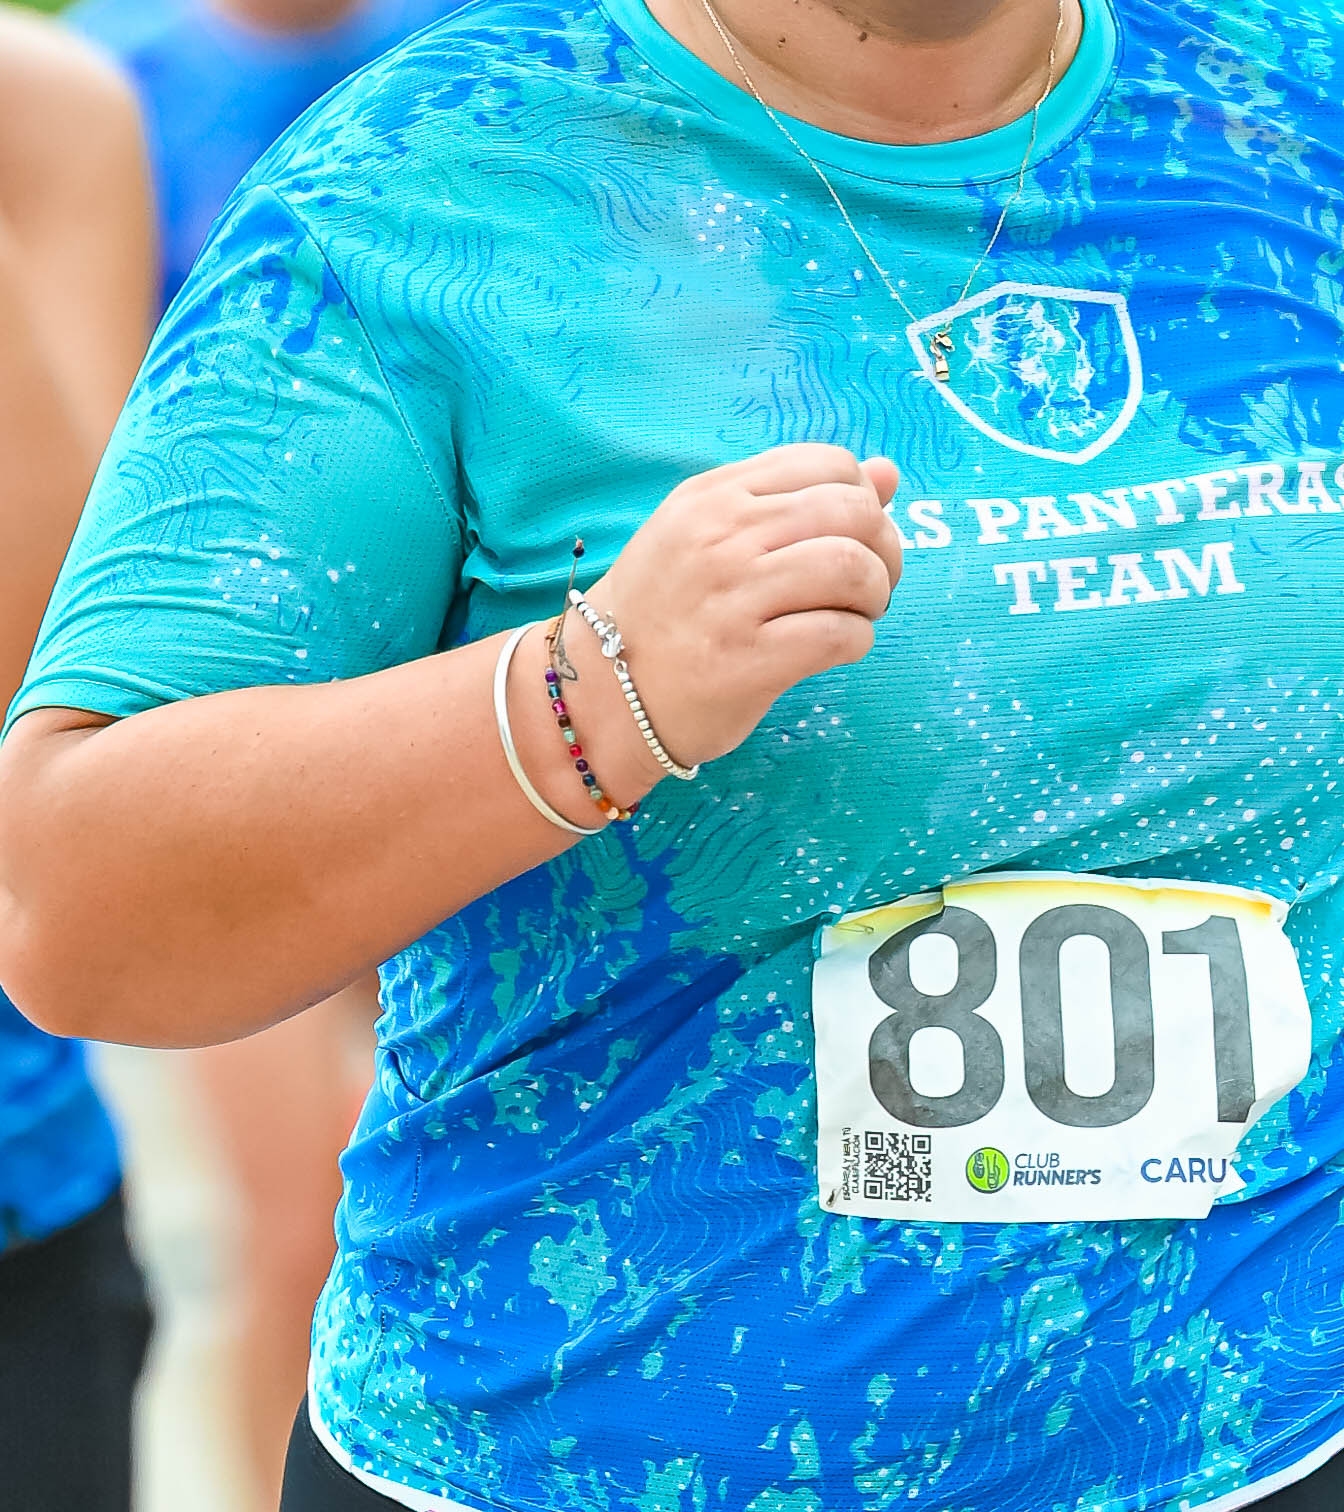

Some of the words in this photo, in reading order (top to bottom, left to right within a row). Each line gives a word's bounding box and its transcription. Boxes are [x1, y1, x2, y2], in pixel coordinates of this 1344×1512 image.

[994, 541, 1246, 616] TEAM
[867, 903, 1257, 1129] 801
[1012, 1168, 1102, 1186] RUNNER'S
[1014, 1152, 1061, 1169] CLUB
